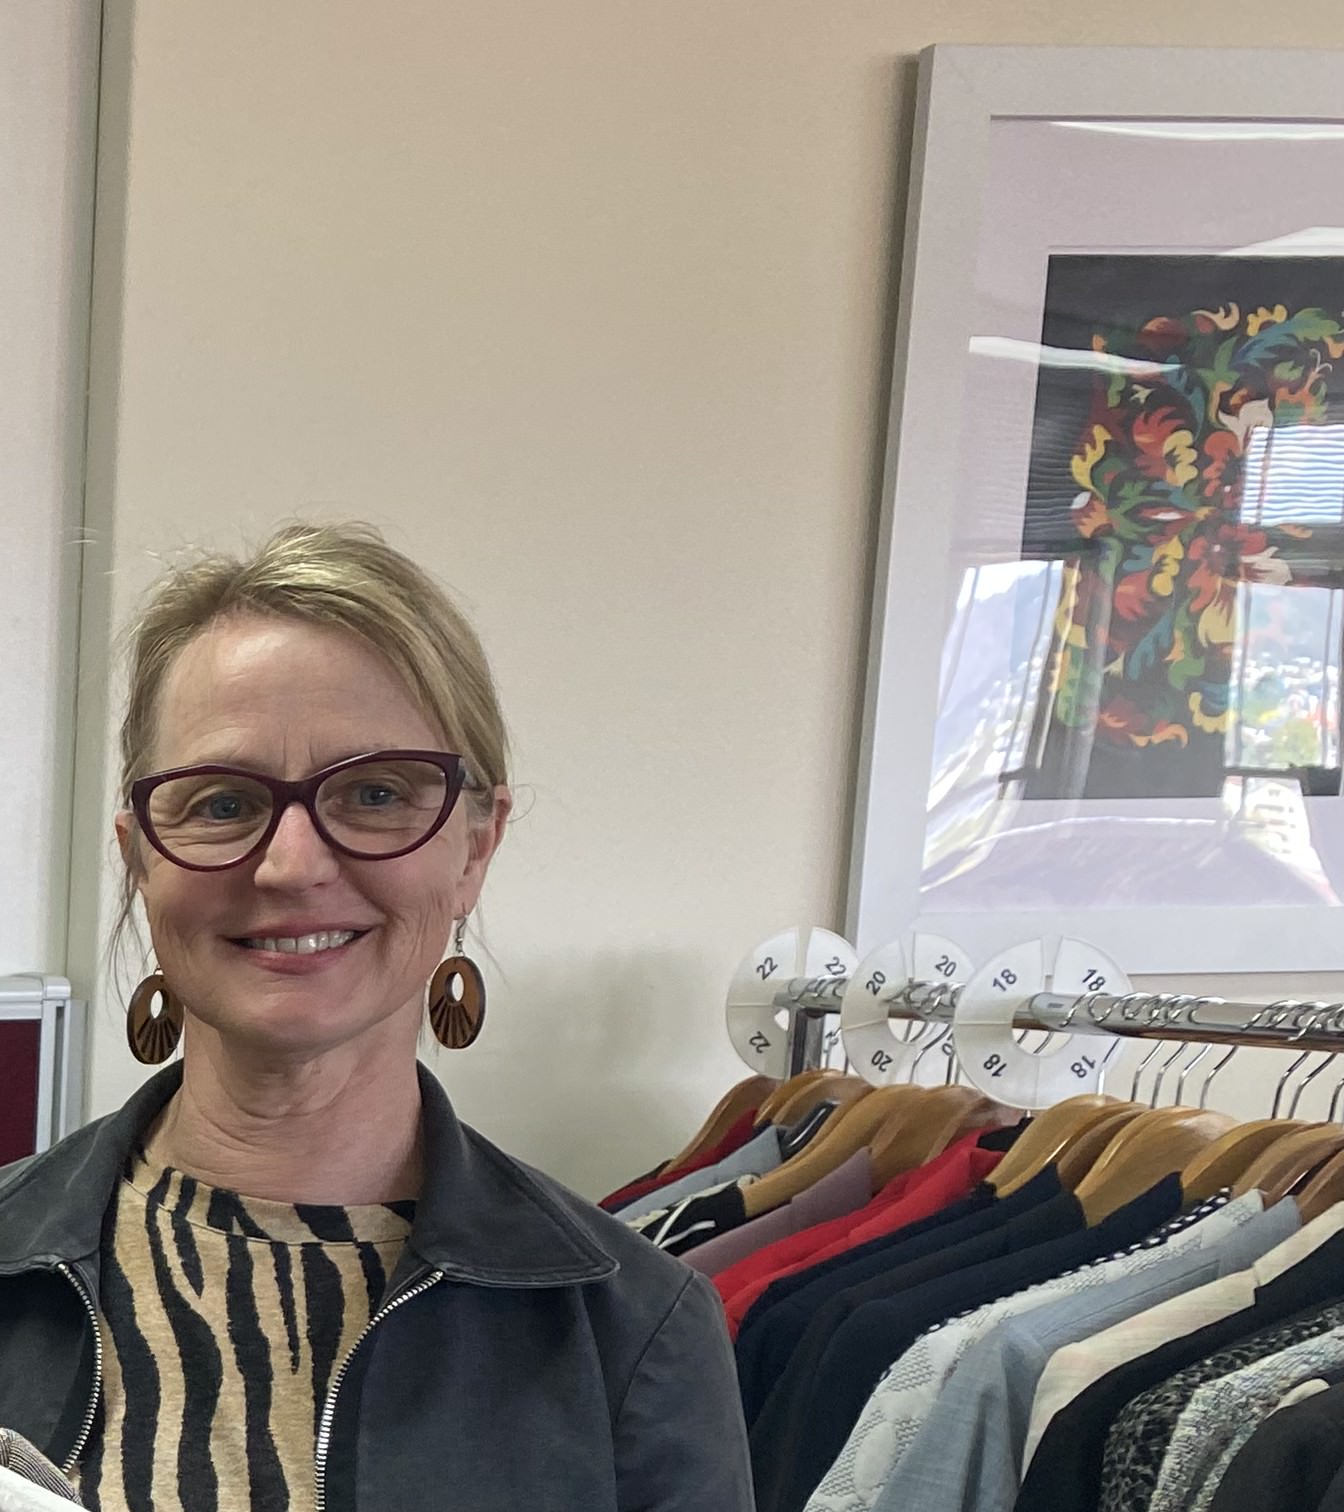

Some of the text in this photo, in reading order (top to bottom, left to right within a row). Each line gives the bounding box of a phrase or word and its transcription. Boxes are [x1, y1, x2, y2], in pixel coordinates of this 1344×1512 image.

[756, 956, 778, 980] 22
[934, 955, 957, 977] 20
[865, 971, 886, 996] 20
[992, 968, 1018, 992] 18
[1081, 968, 1107, 992] 18
[749, 1031, 772, 1054] 22
[871, 1050, 893, 1072] 20
[983, 1053, 1008, 1078] 18
[1070, 1055, 1097, 1079] 18
